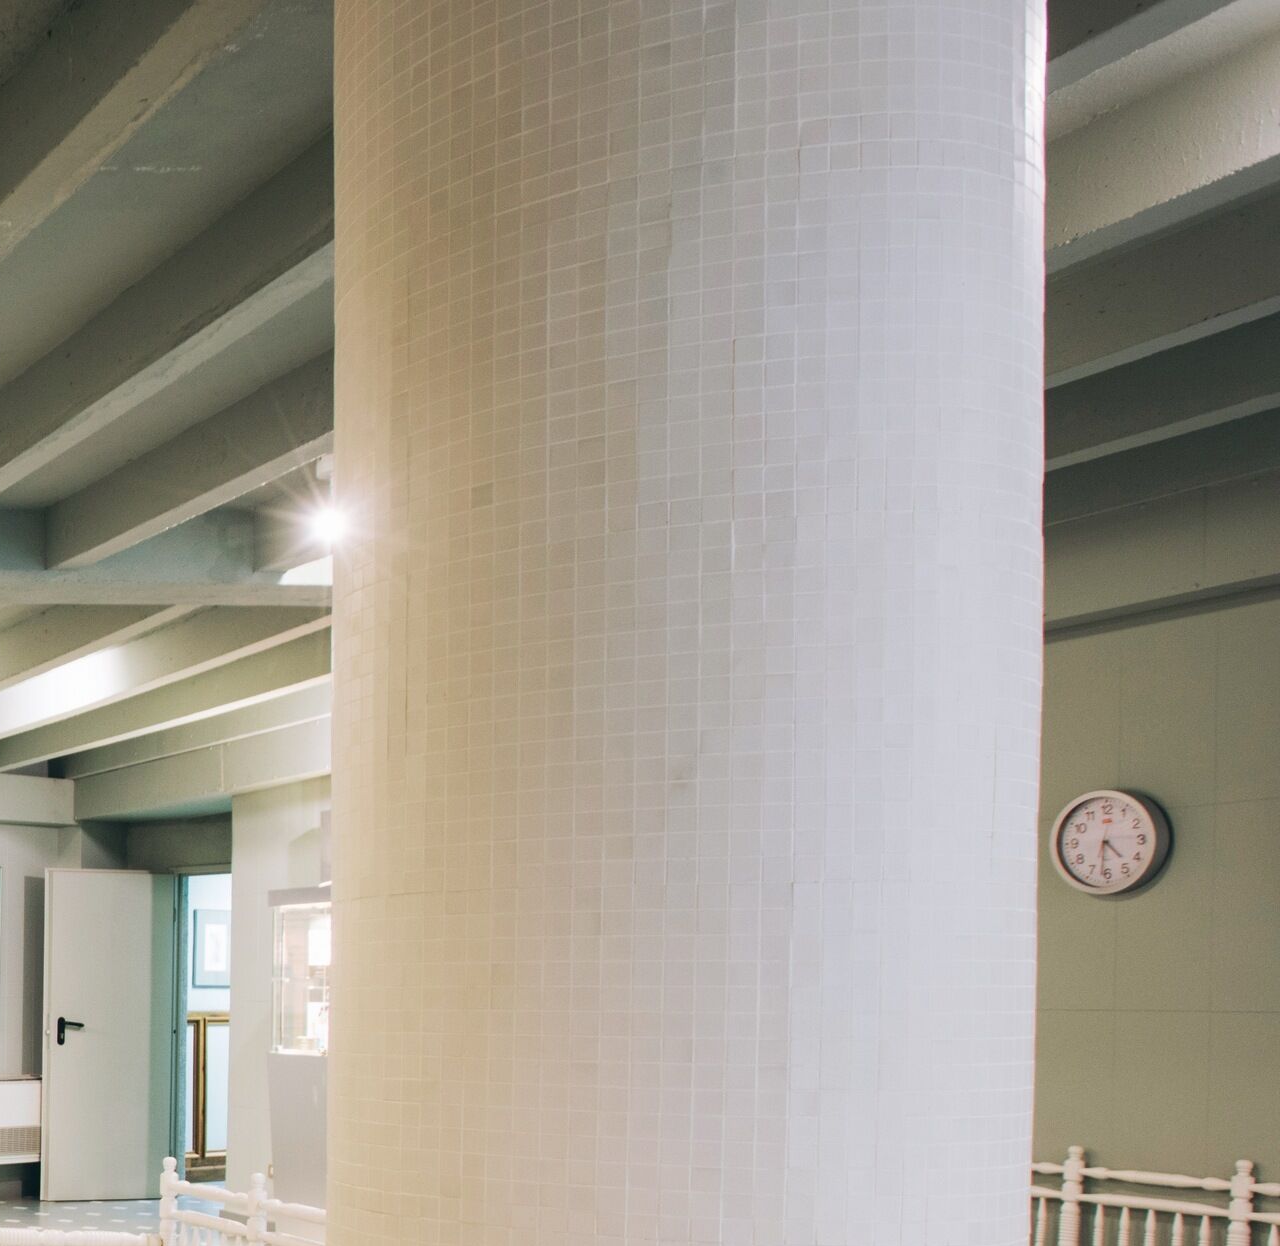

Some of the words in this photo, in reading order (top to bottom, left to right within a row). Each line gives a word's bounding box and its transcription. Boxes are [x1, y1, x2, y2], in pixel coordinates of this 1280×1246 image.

[1101, 804, 1113, 815] 12
[1075, 823, 1087, 834] 10
[1132, 818, 1140, 829] 2
[1071, 839, 1079, 849] 9
[1137, 834, 1146, 845] 3
[1076, 854, 1084, 864] 8
[1133, 852, 1141, 862] 4
[1089, 865, 1096, 875] 7
[1104, 868, 1112, 879] 6
[1121, 863, 1130, 874] 5
